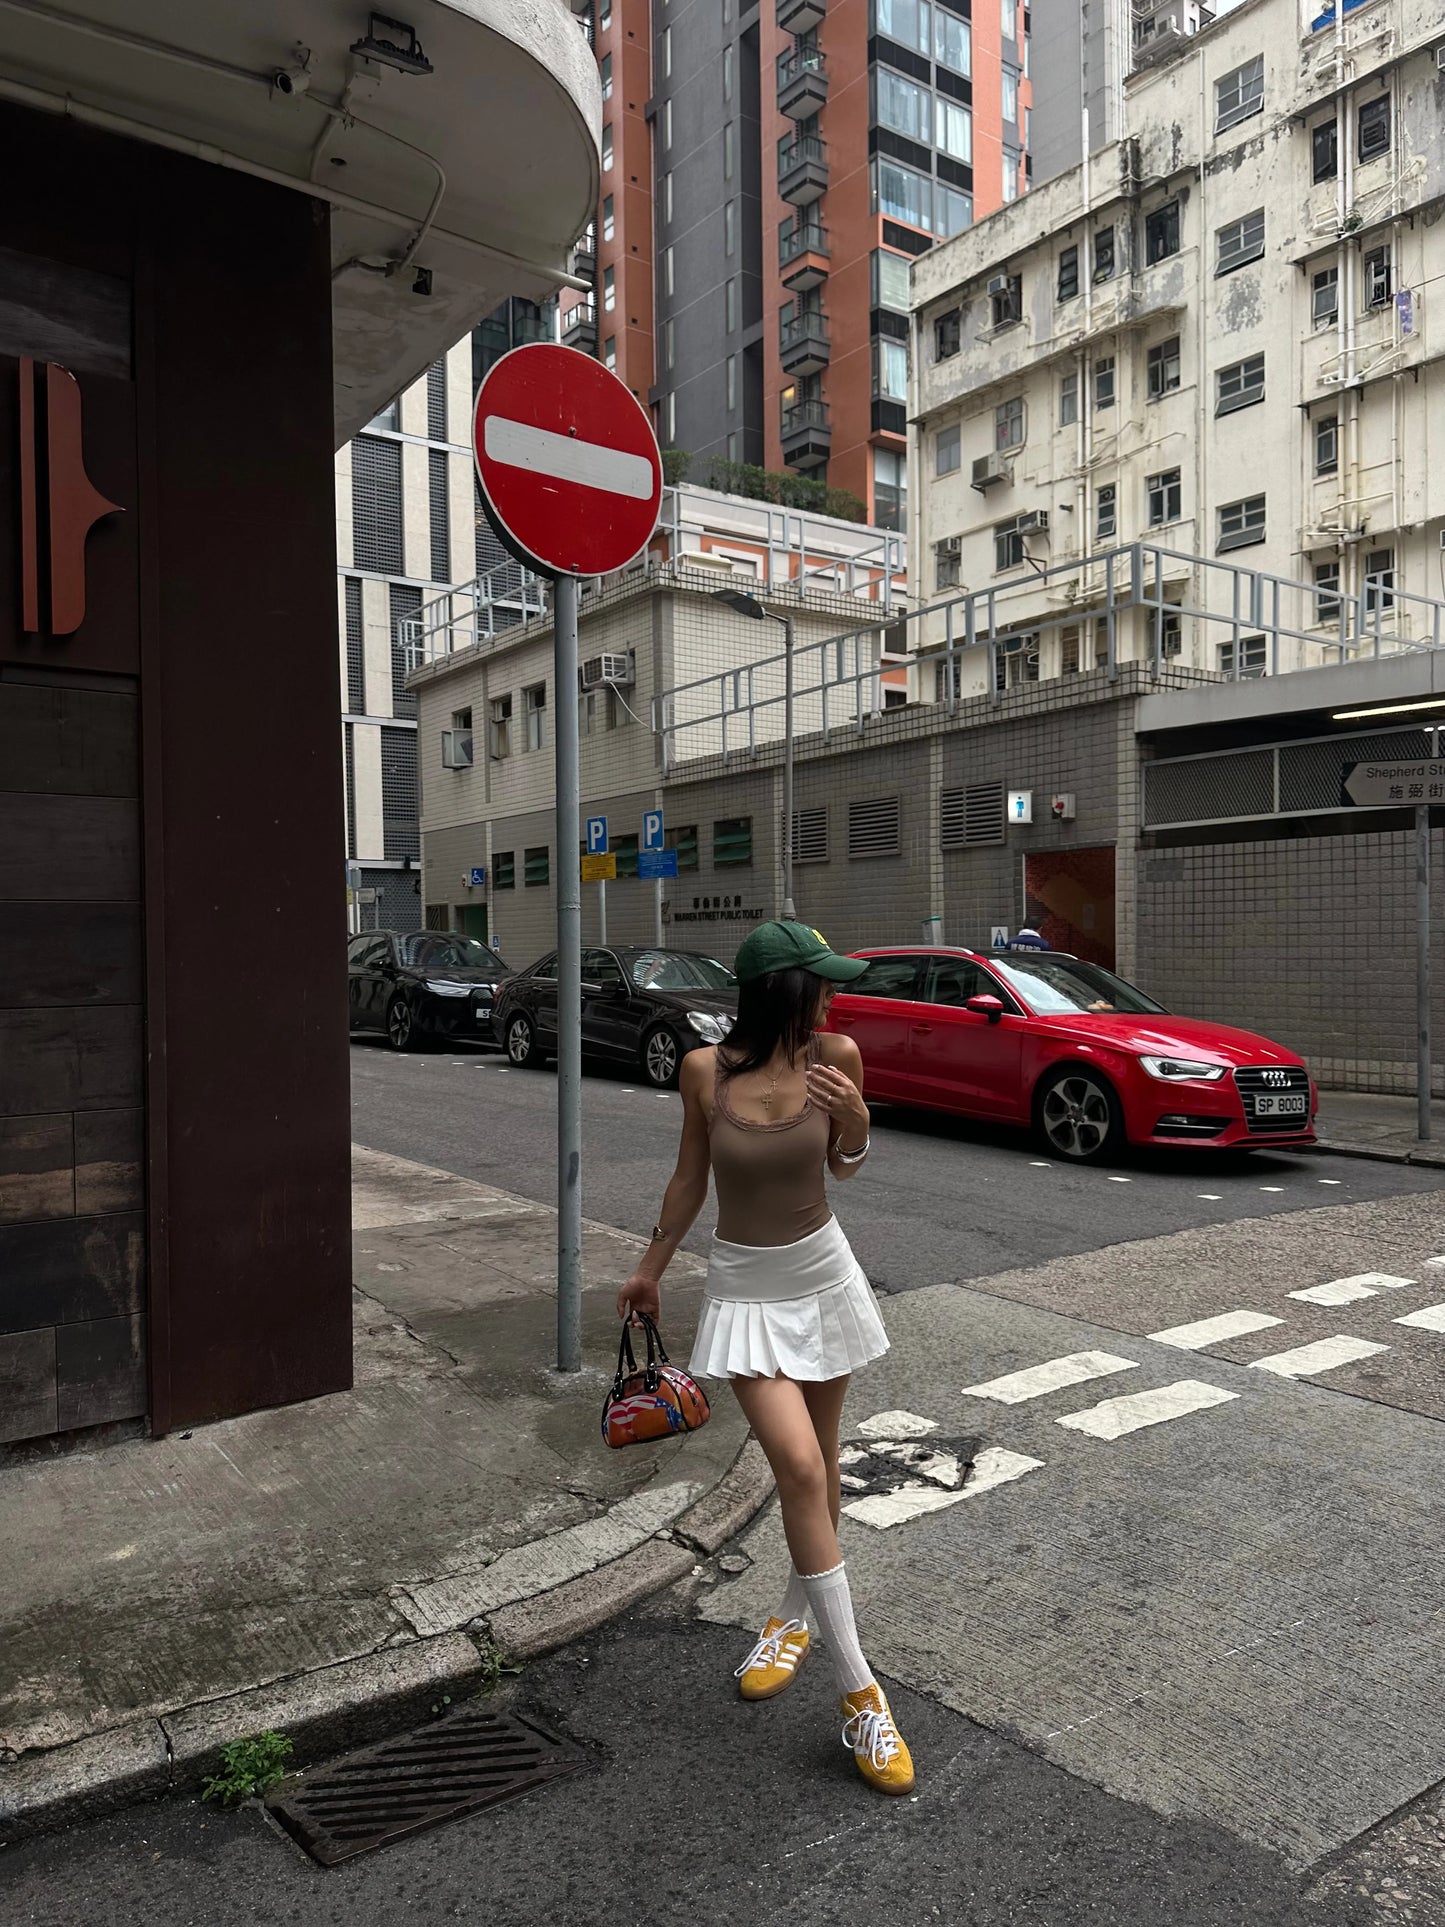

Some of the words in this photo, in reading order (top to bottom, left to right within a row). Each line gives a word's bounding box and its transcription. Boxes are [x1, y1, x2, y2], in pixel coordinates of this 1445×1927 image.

[1366, 765, 1425, 779] Shepherd
[590, 821, 604, 850] P
[646, 816, 660, 846] P
[697, 910, 720, 921] STREET
[720, 909, 742, 920] PUBLIC
[742, 908, 764, 919] TOILET
[1258, 1098, 1274, 1112] SP
[1278, 1097, 1303, 1112] 8003
